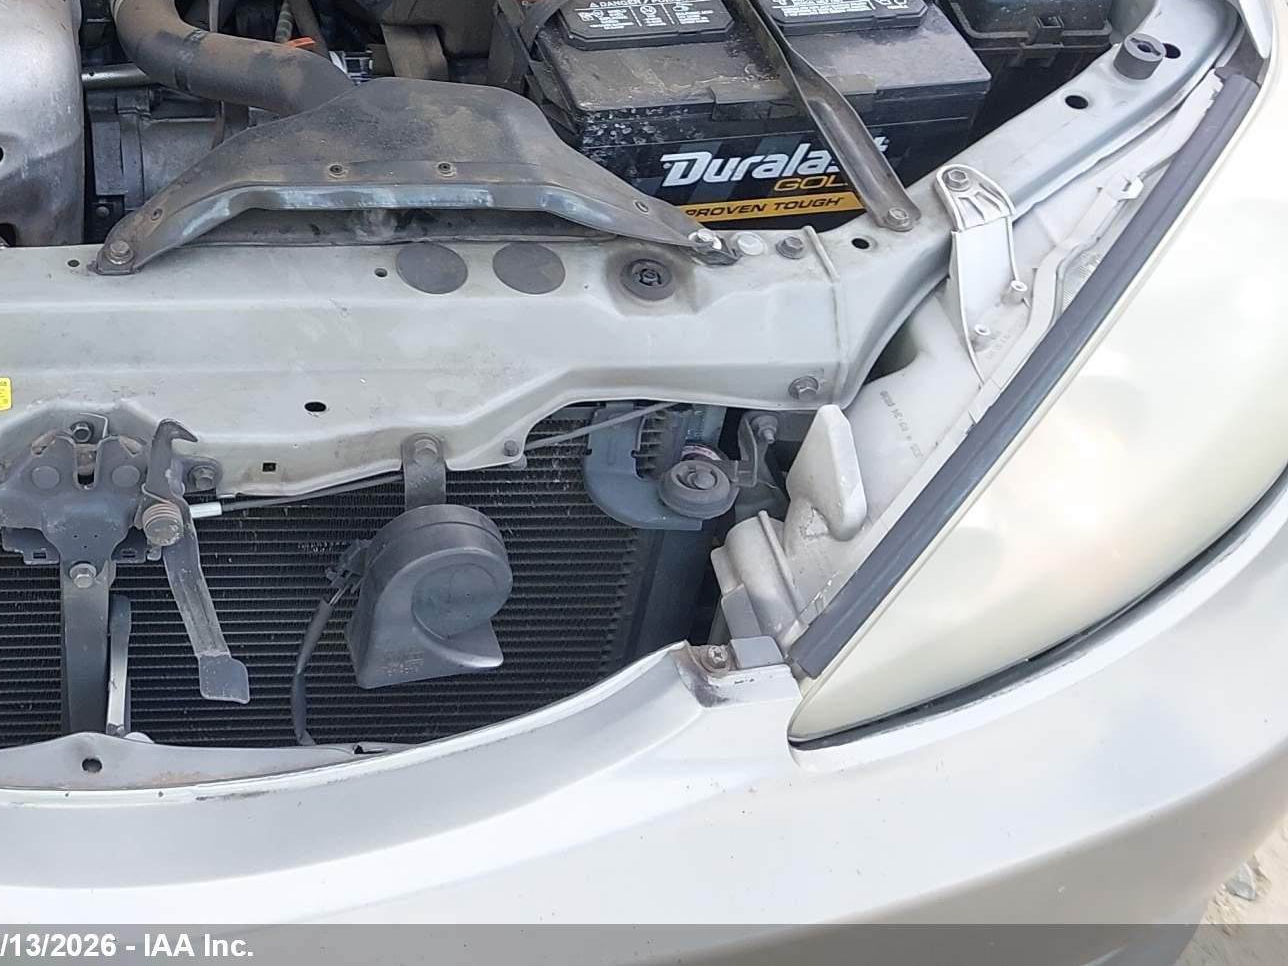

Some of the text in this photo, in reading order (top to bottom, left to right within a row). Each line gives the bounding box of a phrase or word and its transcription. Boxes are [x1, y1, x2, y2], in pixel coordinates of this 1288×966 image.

[599, 0, 642, 8] DANGER
[774, 175, 848, 191] GOL
[774, 198, 842, 211] TOUGH
